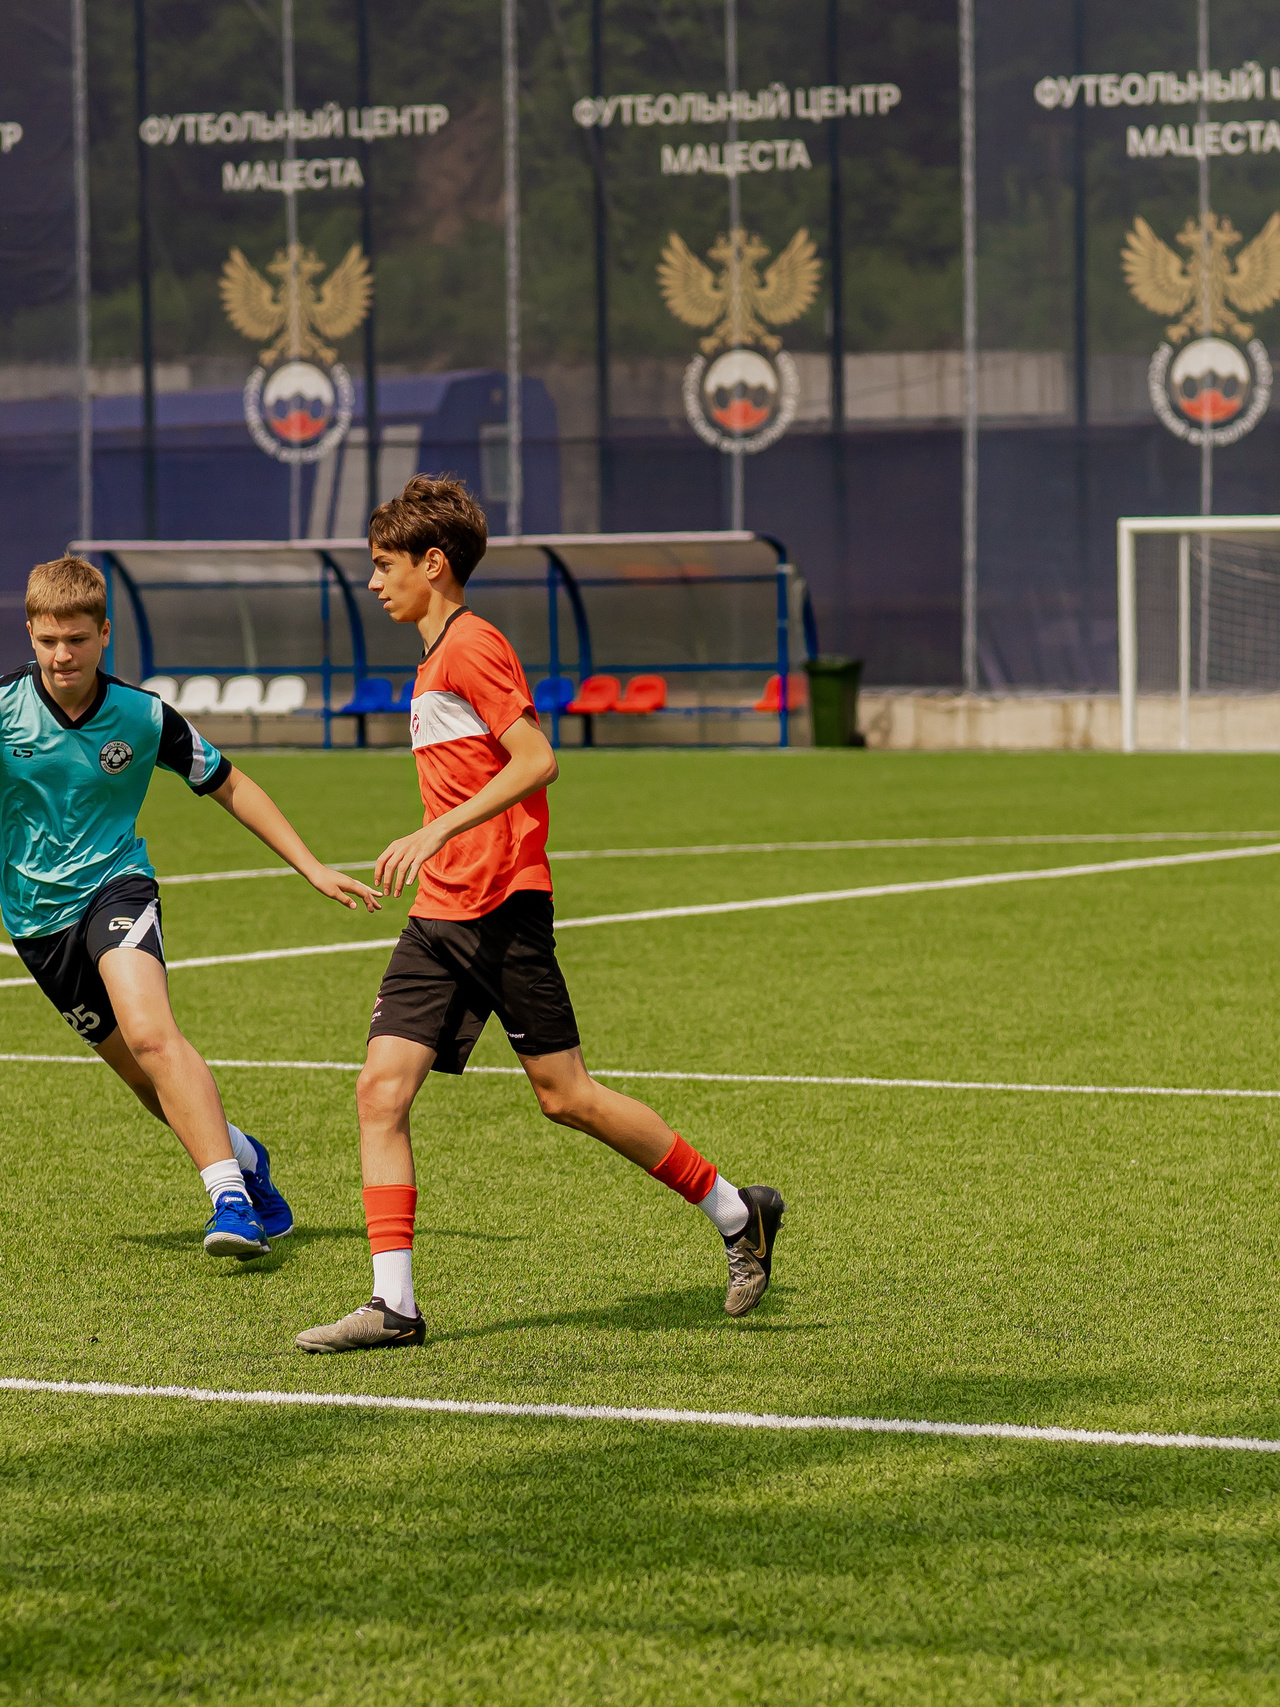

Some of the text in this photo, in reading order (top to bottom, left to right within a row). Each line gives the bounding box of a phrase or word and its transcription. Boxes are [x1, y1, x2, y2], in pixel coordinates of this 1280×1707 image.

[572, 81, 902, 128] ФУТБОЛЬНЫЙ ЦЕНТР
[1034, 60, 1265, 110] ФУТБОЛЬНЫЙ
[139, 101, 450, 146] ФУТБОЛЬНЫЙ ЦЕНТР
[1126, 119, 1280, 161] МАЦЕСТА
[221, 156, 365, 194] МАЦЕСТА
[660, 139, 812, 179] МАЦЕСТА
[62, 1003, 101, 1035] 25
